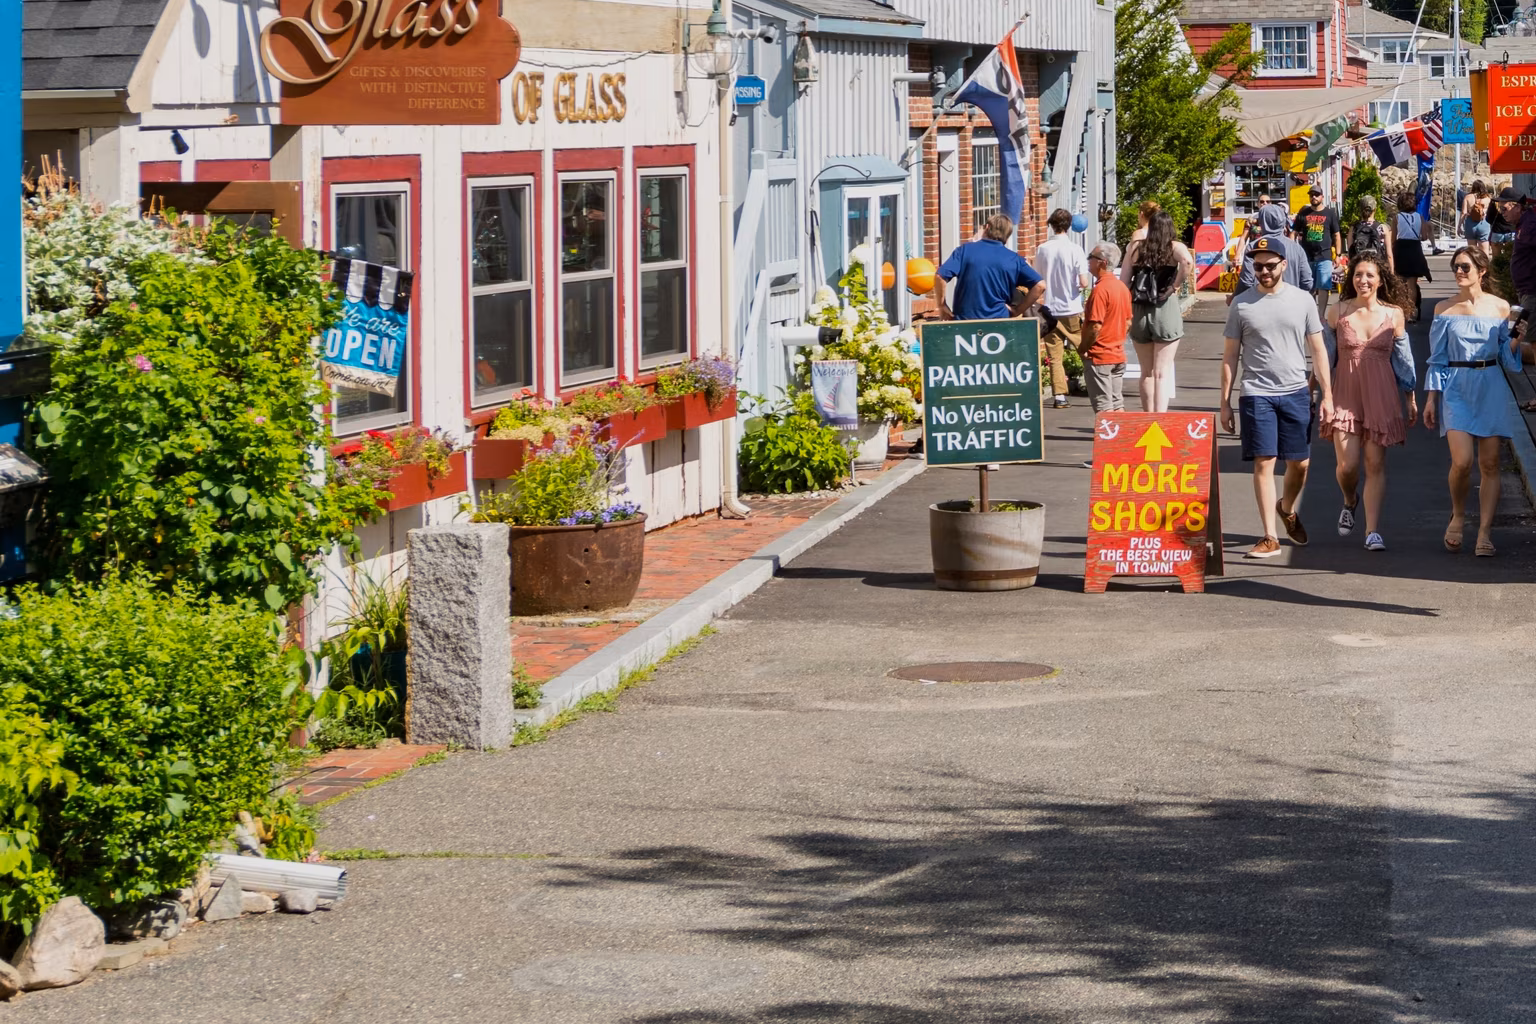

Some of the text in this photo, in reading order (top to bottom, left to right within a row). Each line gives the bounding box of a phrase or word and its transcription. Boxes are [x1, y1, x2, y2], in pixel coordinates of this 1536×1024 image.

[349, 66, 486, 77] GIFTS & DISCOVERIES
[360, 81, 486, 94] WITH DISTINCTIVE
[408, 98, 486, 109] DIFFERENCE
[512, 71, 627, 124] OF GLASS
[1496, 104, 1523, 118] ICE
[365, 317, 401, 336] are
[325, 328, 397, 369] OPEN
[955, 332, 1006, 356] NO
[323, 365, 351, 382] Come
[812, 365, 857, 378] Welcome
[928, 361, 1034, 388] PARKING
[931, 403, 1033, 425] No Vehicle
[932, 428, 1033, 451] TRAFFIC
[1102, 463, 1199, 493] MORE
[1091, 501, 1206, 532] SHOPS
[1130, 537, 1161, 549] PLUS
[1099, 549, 1192, 561] THE BEST VIEW
[1116, 562, 1174, 573] IN TOWN!
